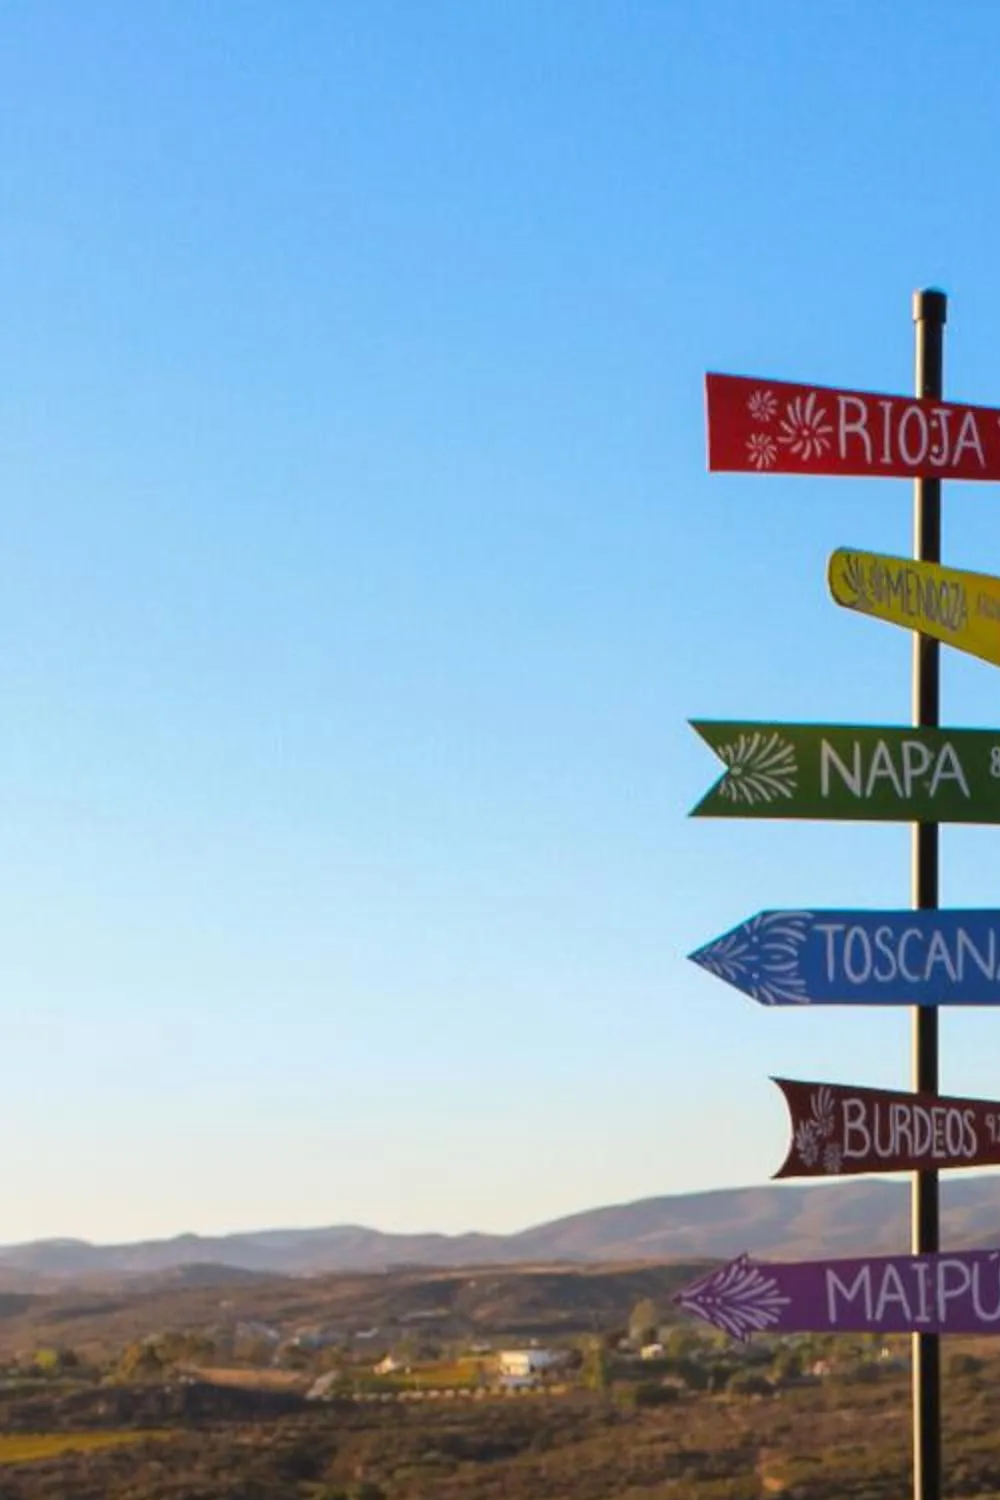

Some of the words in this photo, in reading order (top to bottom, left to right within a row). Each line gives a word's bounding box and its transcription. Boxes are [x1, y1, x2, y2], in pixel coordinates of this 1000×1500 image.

[837, 395, 987, 469] RIOJA
[820, 737, 971, 799] NAPA
[841, 1098, 978, 1158] BURDEOS
